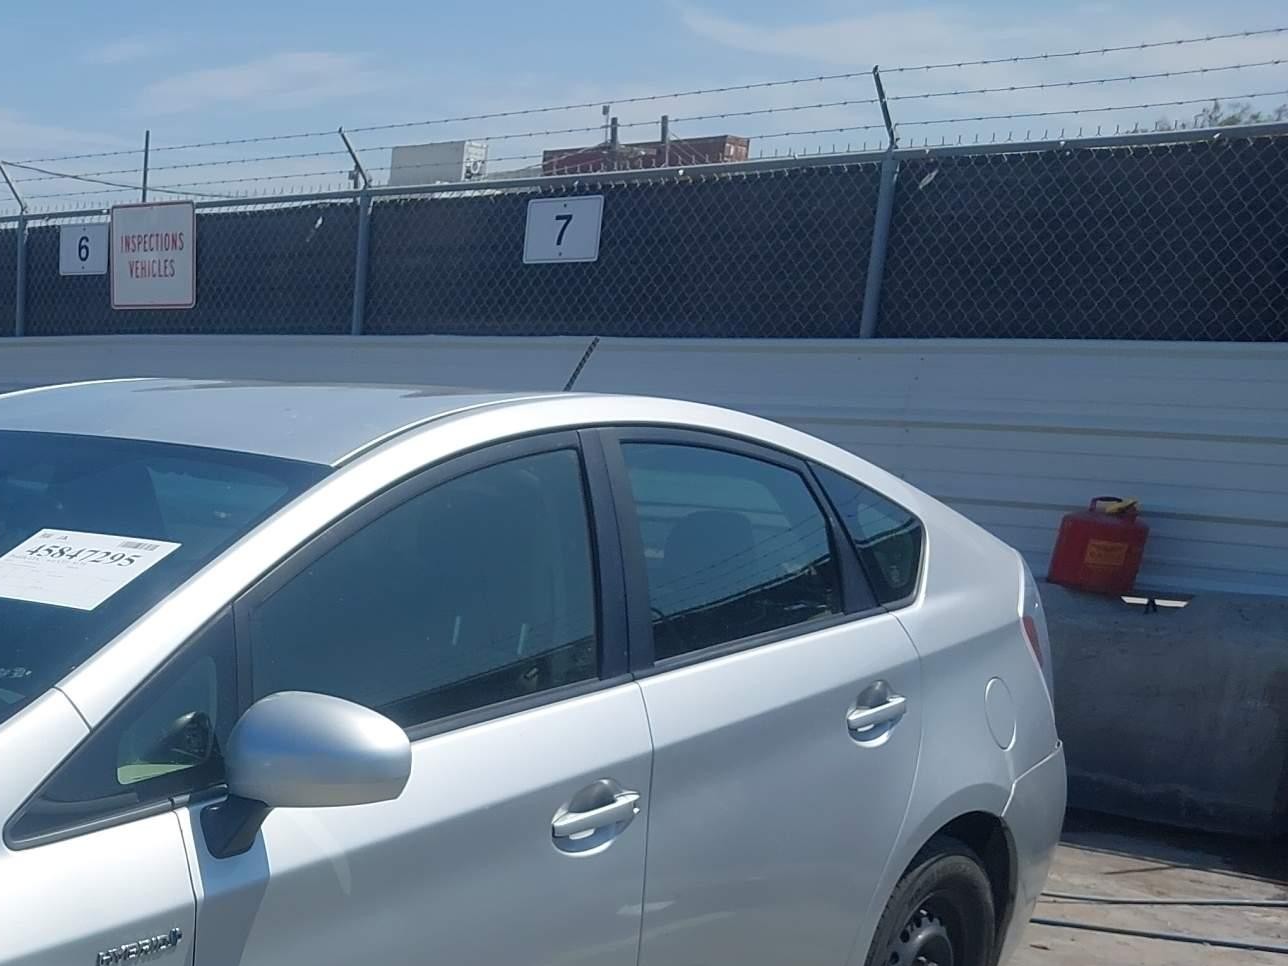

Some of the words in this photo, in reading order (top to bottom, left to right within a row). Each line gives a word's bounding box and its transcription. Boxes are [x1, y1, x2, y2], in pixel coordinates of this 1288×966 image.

[555, 214, 573, 246] 7
[78, 236, 90, 261] 6
[120, 232, 185, 254] INSPECTIONS
[128, 259, 176, 278] VEHICLES
[26, 543, 143, 567] 45847295
